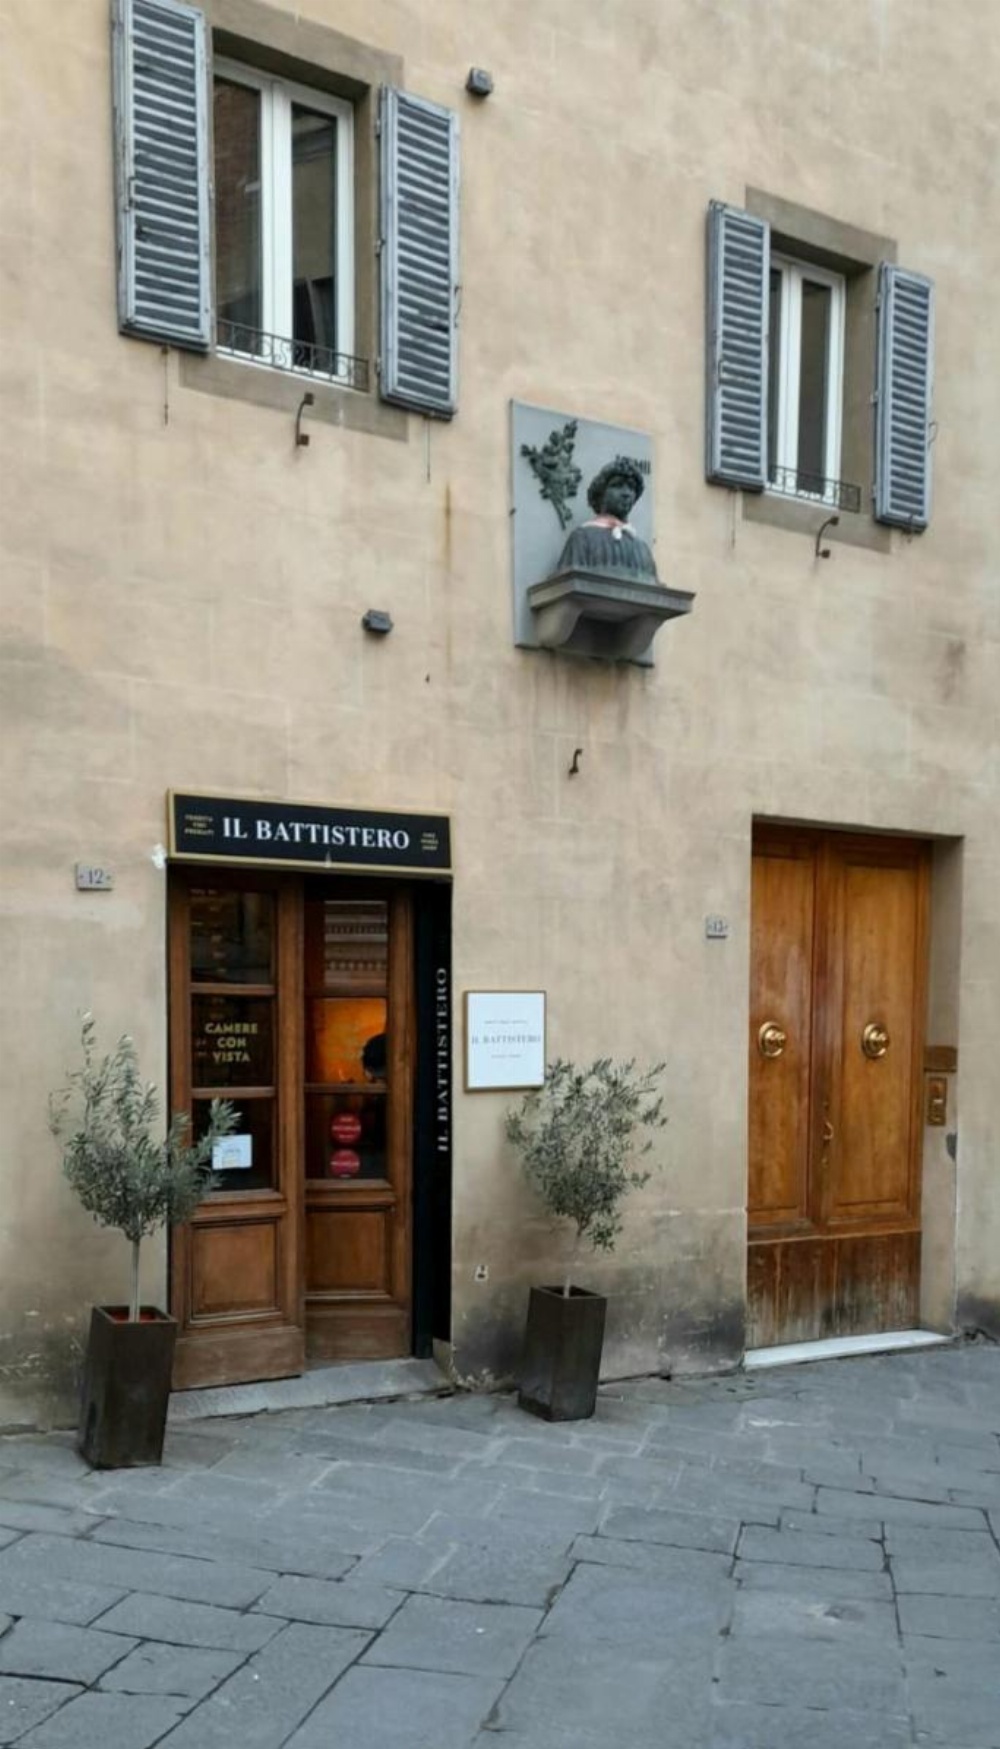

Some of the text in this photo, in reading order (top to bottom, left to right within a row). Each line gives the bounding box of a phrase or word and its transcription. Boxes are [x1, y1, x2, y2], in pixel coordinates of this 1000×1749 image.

[222, 817, 247, 839] IL
[256, 819, 410, 850] BATTISTERO
[88, 867, 104, 885] 12
[205, 1023, 258, 1034] CAMERE
[217, 1036, 247, 1048] CON
[436, 967, 448, 1121] BATTISTERO
[212, 1051, 251, 1063] VISTA
